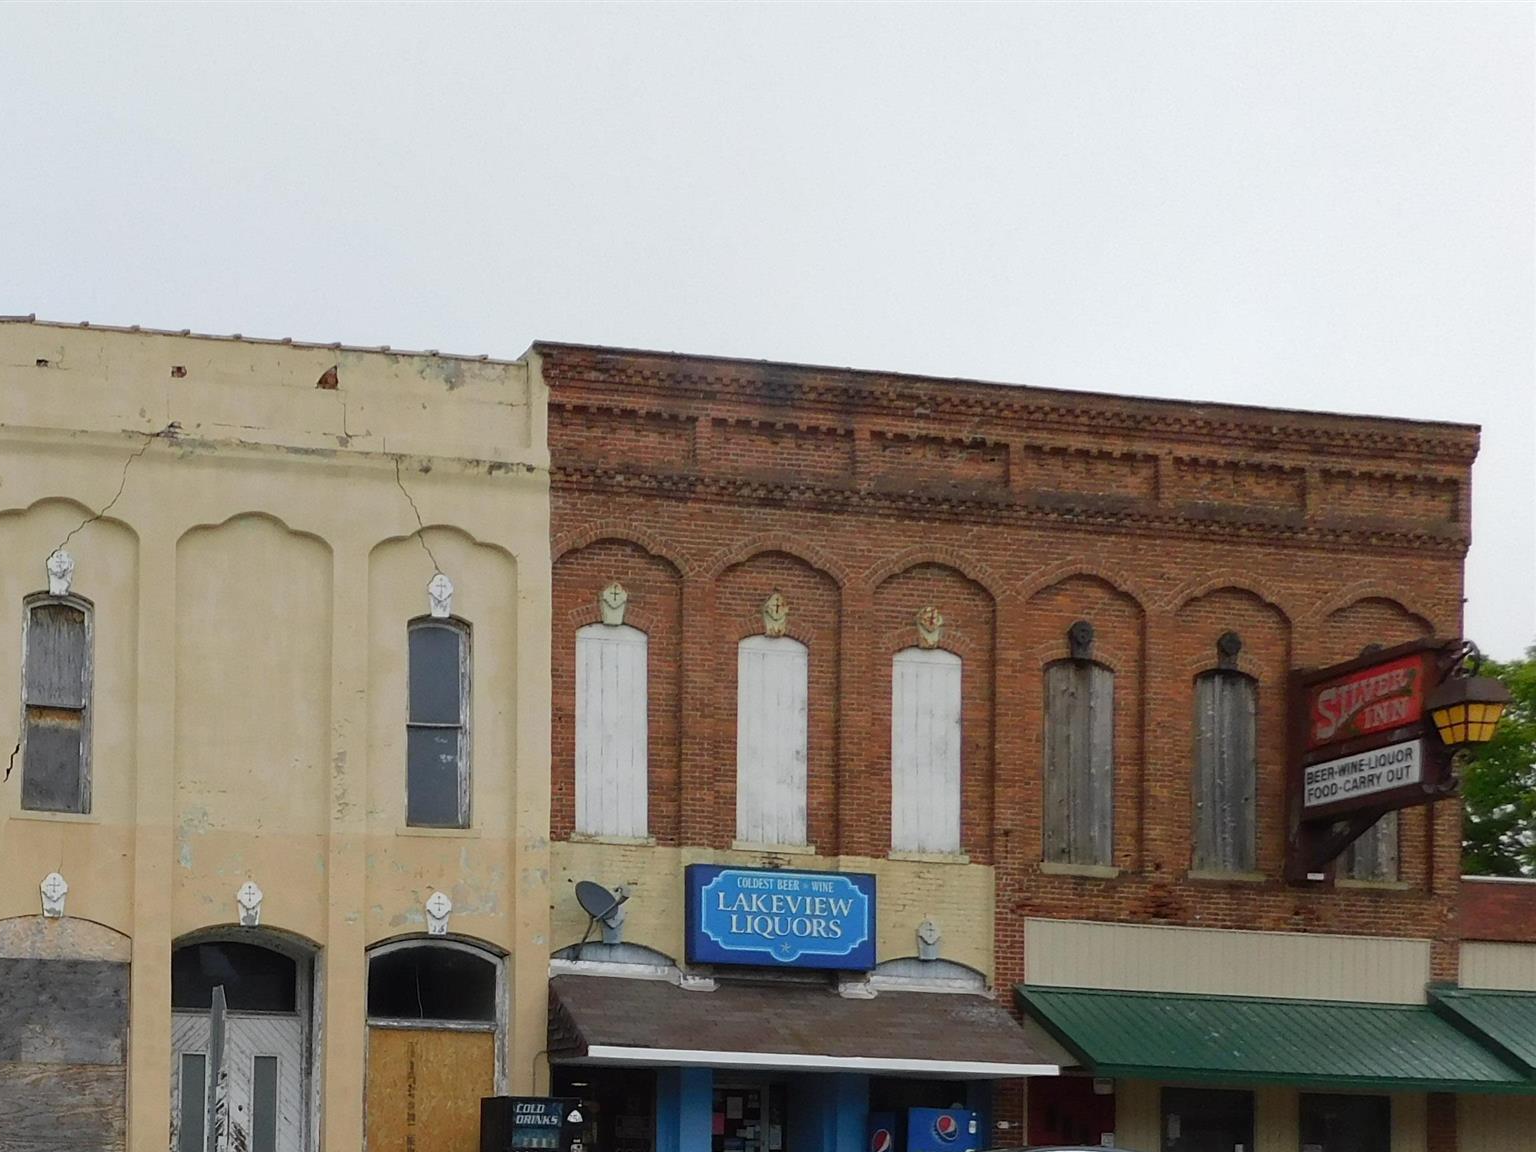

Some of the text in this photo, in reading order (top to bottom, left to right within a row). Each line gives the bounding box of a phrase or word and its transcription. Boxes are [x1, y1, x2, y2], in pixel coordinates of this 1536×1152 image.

[1316, 667, 1409, 739] SILVER
[1364, 696, 1409, 729] INN
[1386, 765, 1412, 783] OUT
[737, 877, 834, 893] COLDEST BEER WINE
[717, 892, 854, 917] LAKEVIEW
[730, 914, 842, 939] LIQUORS
[516, 1103, 545, 1113] COLD
[516, 1114, 559, 1125] DRINKS
